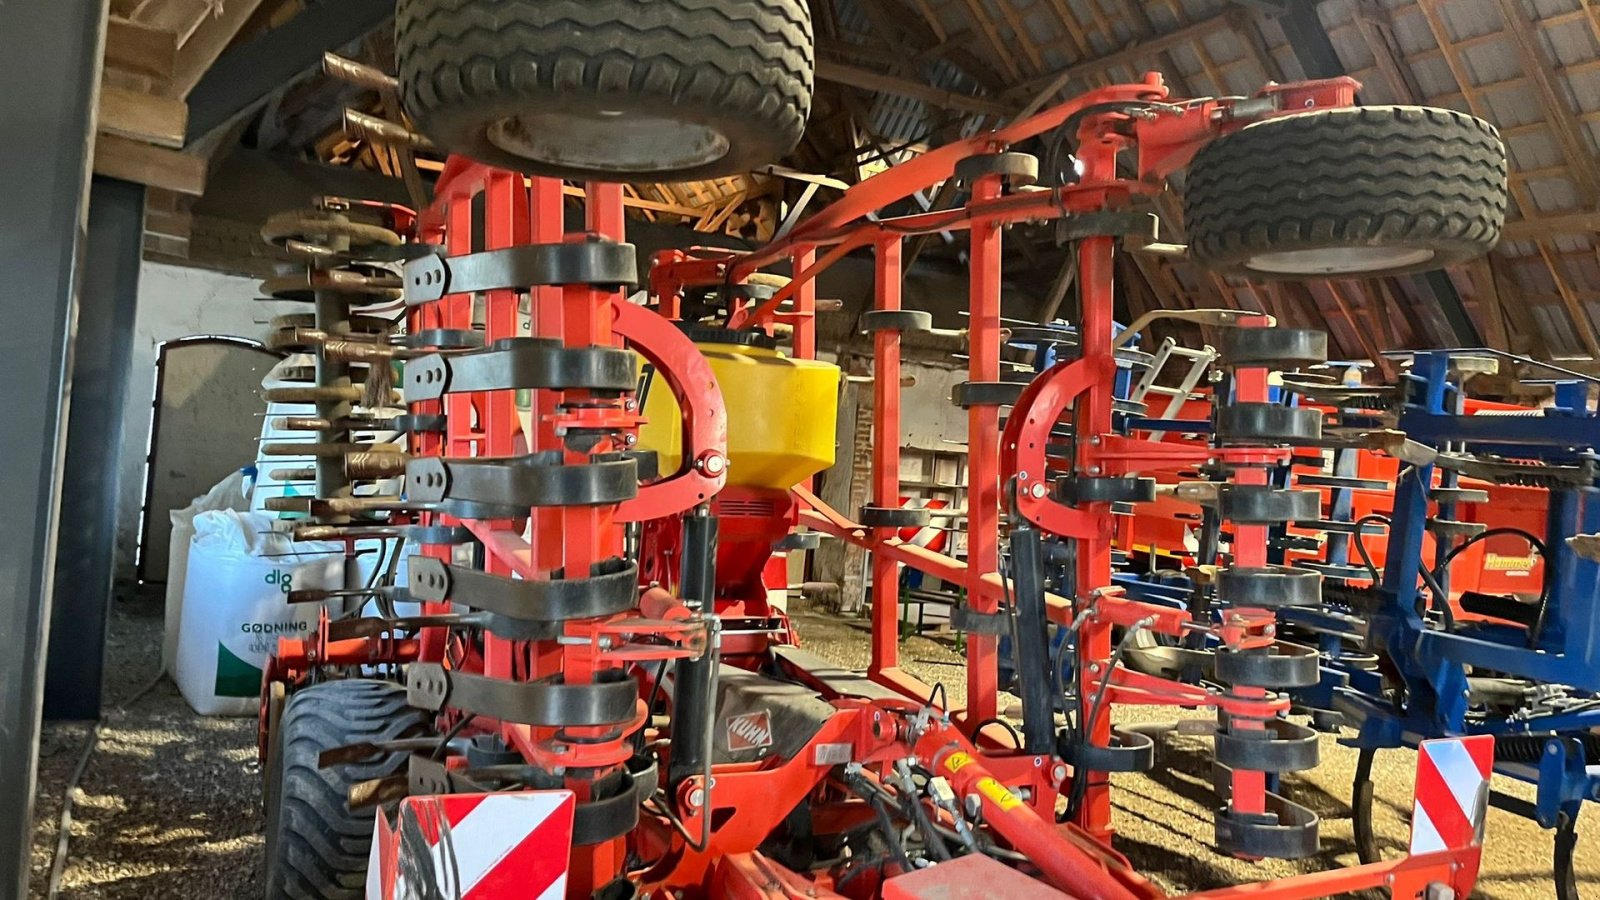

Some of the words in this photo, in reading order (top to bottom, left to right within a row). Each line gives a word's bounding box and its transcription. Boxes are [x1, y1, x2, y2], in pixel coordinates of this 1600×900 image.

[265, 569, 292, 594] dlg
[241, 621, 307, 634] GØDNING
[728, 716, 769, 747] KUHN
